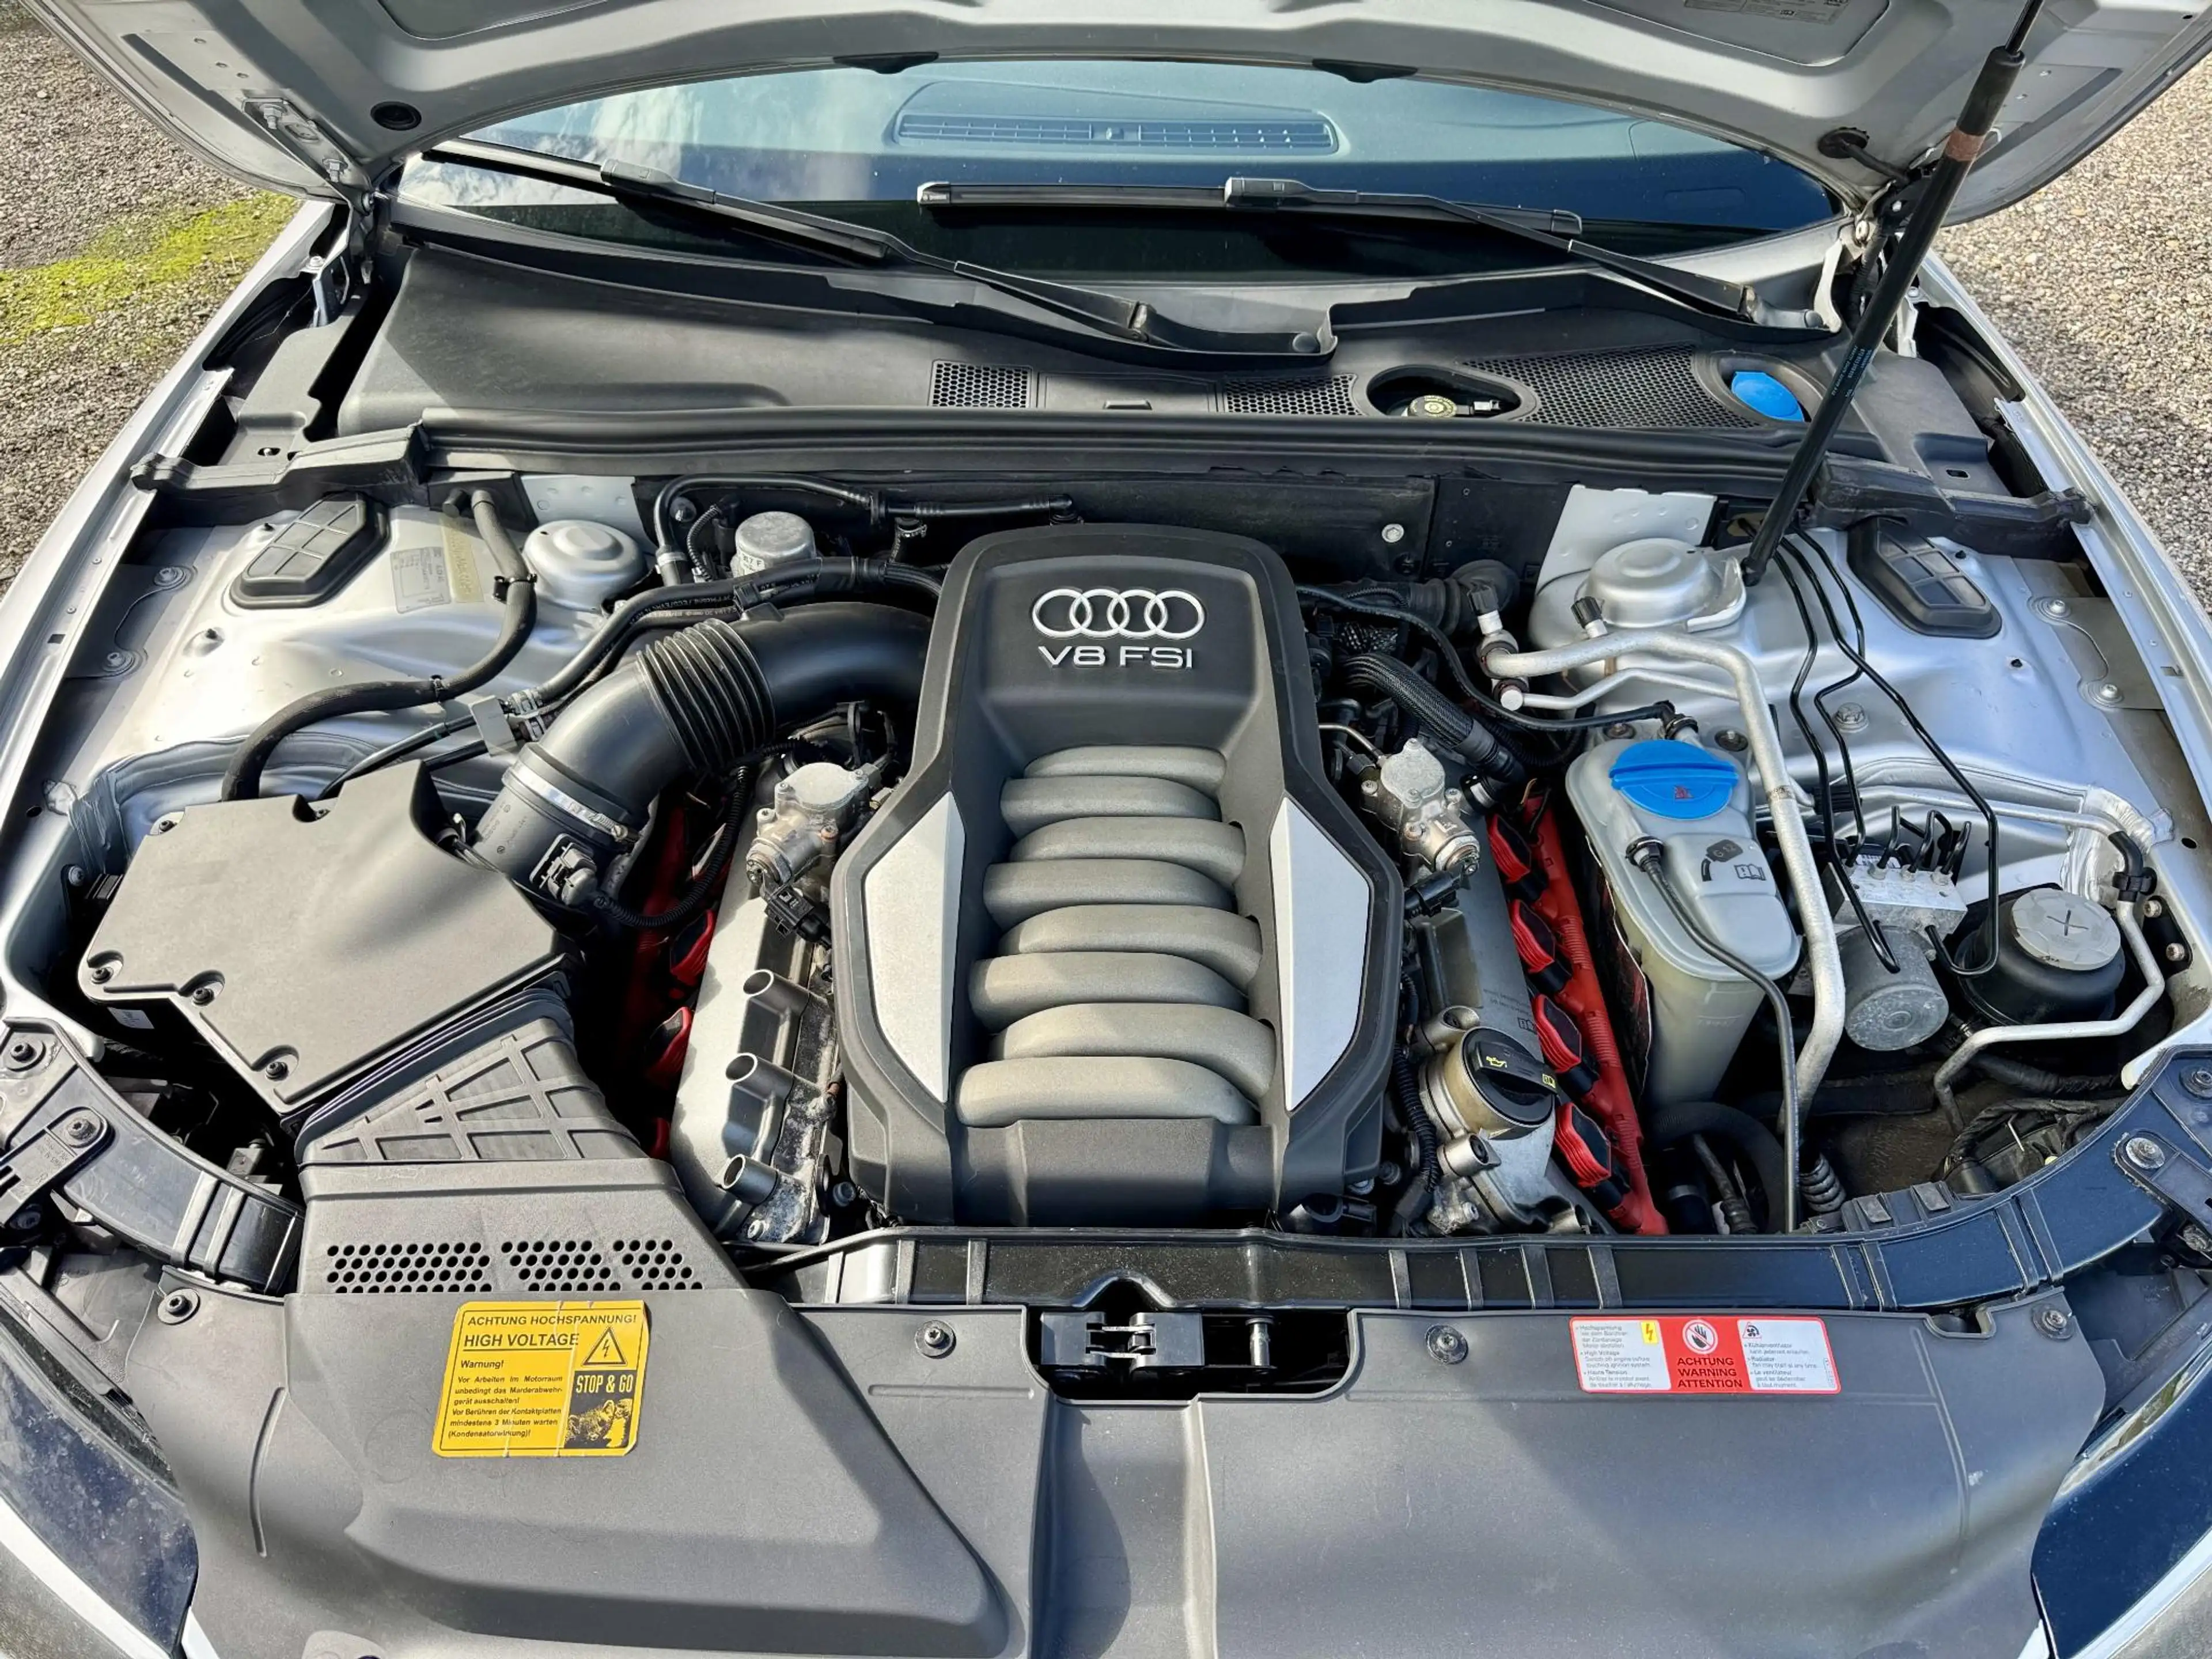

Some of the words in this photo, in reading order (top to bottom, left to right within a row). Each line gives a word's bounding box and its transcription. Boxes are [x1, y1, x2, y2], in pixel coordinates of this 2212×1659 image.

[1037, 645, 1106, 668] V8
[1119, 646, 1193, 669] FSI
[468, 1316, 527, 1325] ACHTUNG
[531, 1314, 637, 1325] HOCHSPANNUNG!
[464, 1334, 503, 1347] HIGH
[507, 1333, 579, 1347] VOLTAGE
[461, 1359, 504, 1369] Warnung!
[1677, 1357, 1734, 1365] ACHTUNG
[1677, 1368, 1737, 1376] WARNING
[576, 1374, 604, 1393] STOP
[606, 1374, 615, 1393] &
[619, 1374, 634, 1392] GO
[1677, 1379, 1743, 1388] ATTENTION
[454, 1387, 491, 1395] unbedingt
[510, 1408, 562, 1416] Kontaktplatten
